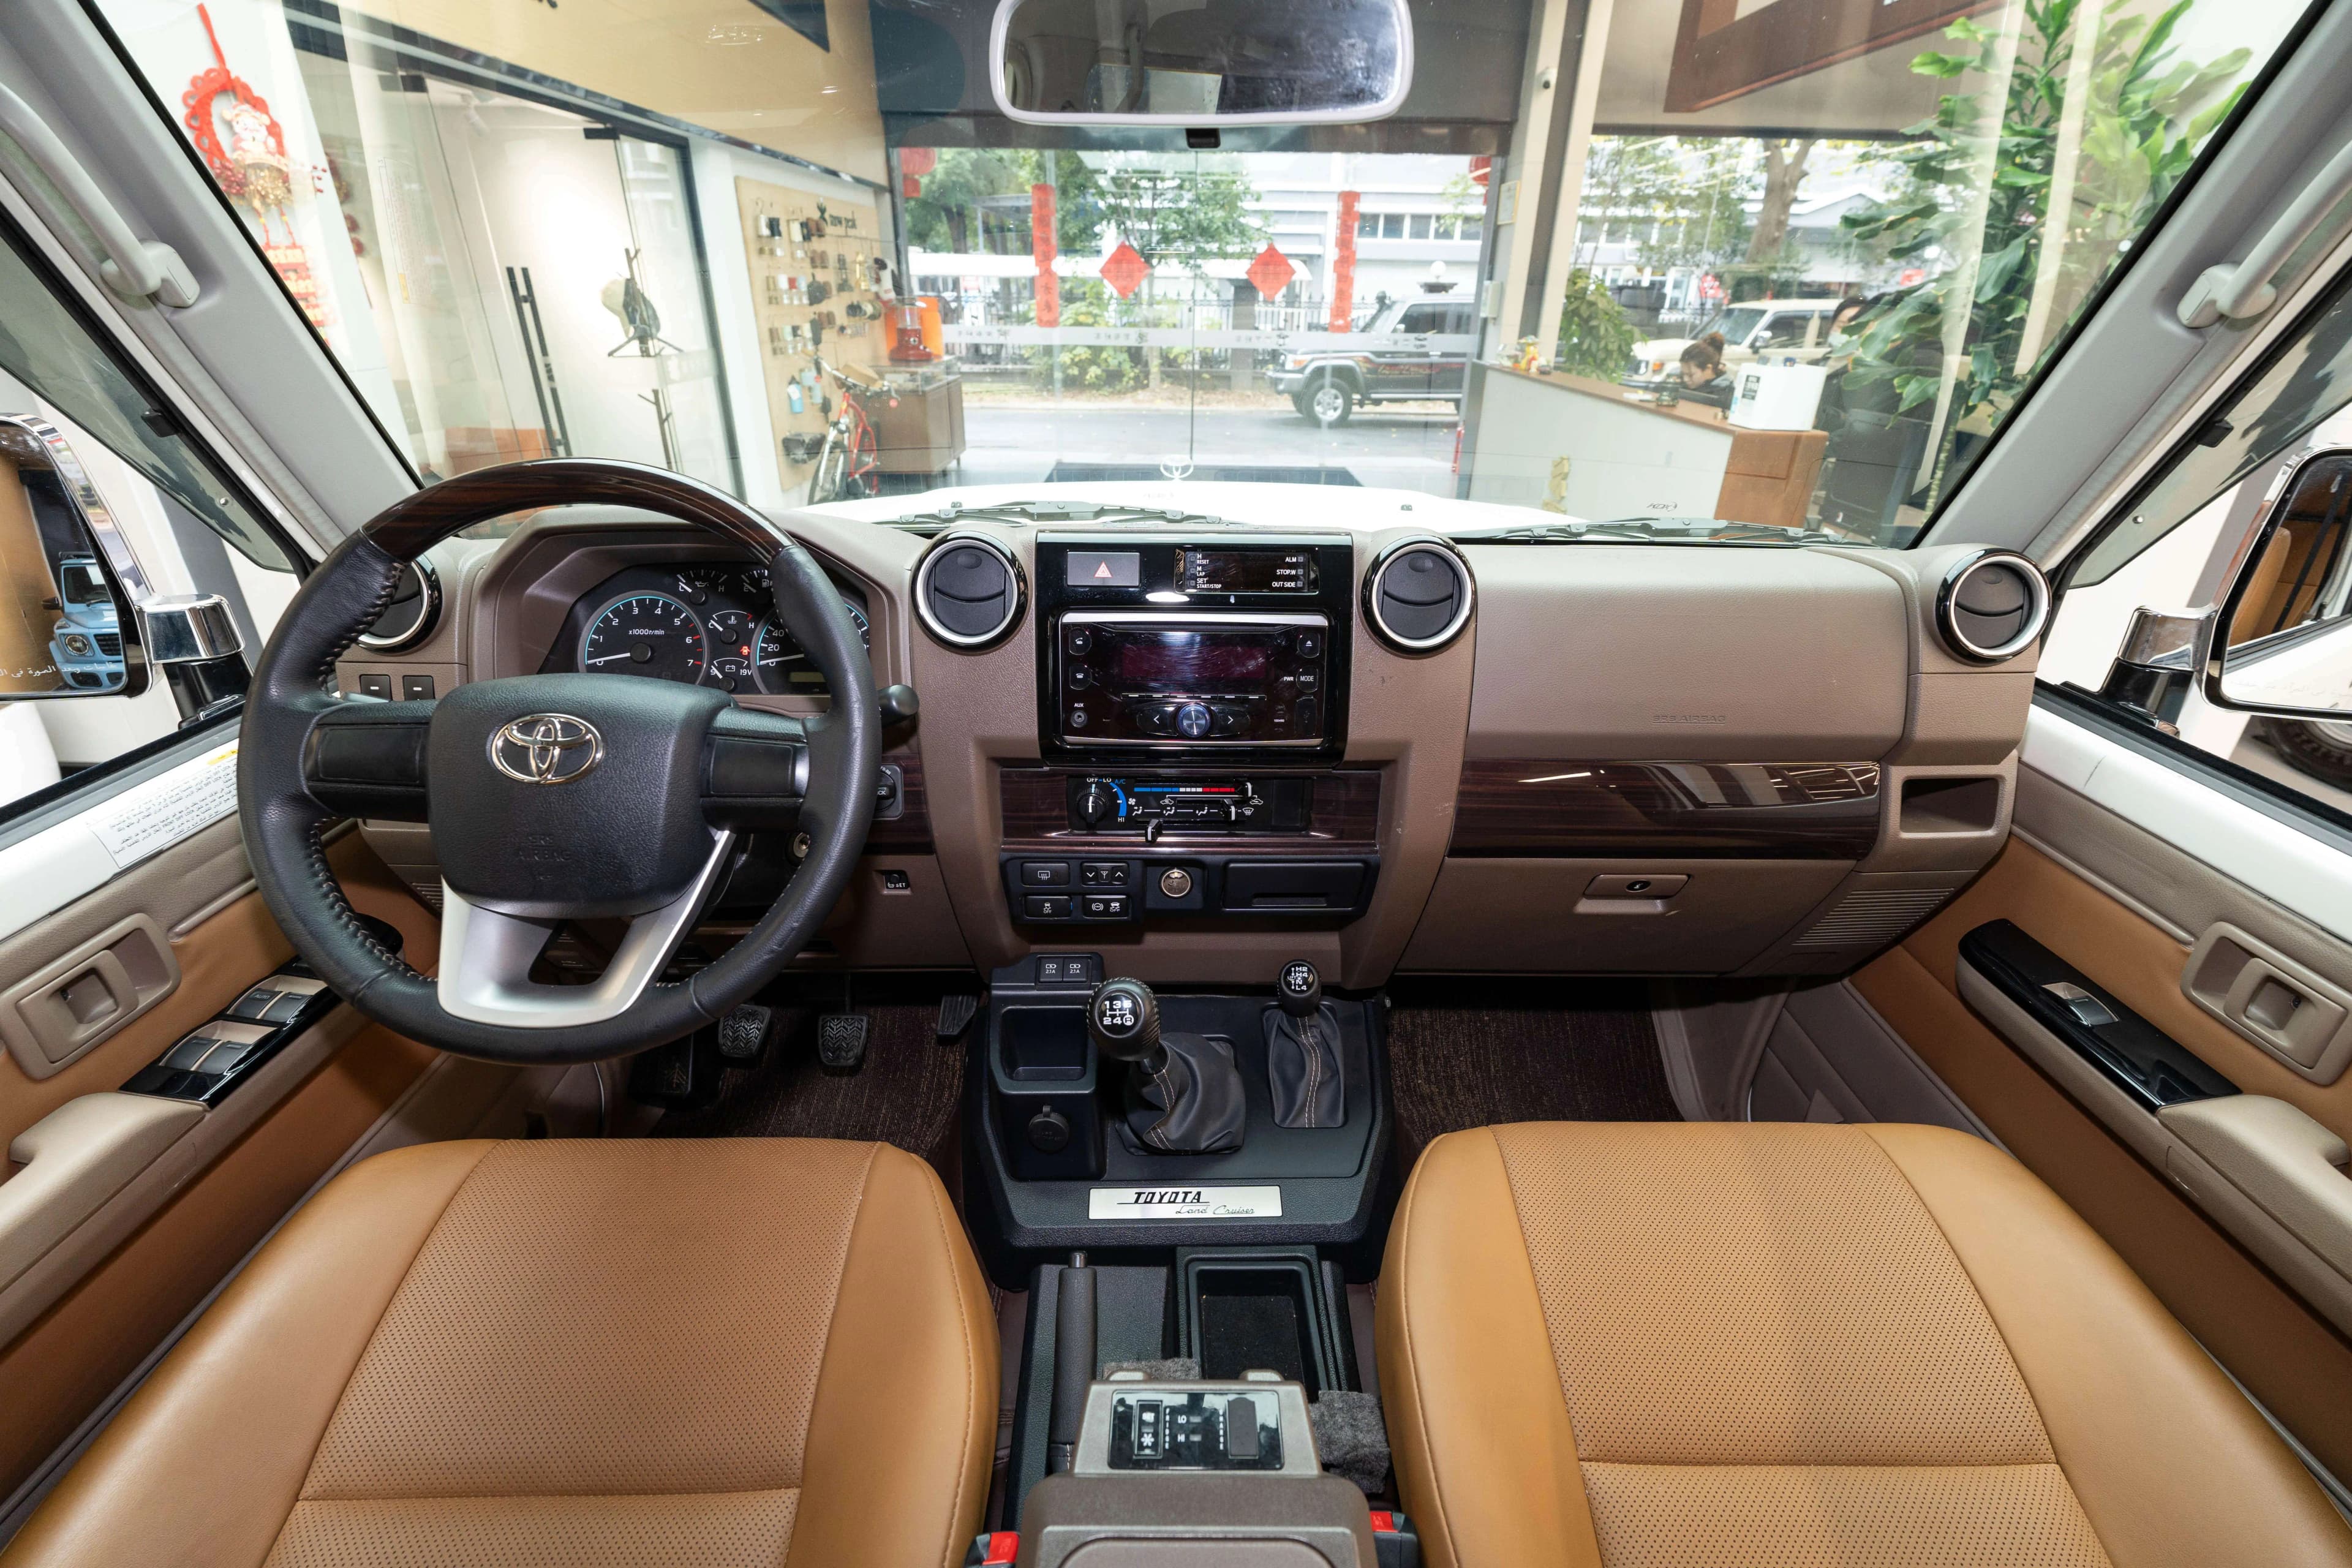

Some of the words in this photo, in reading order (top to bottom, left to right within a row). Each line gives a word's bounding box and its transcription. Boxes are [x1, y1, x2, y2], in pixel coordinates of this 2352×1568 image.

[27, 665, 56, 677] الصورة
[1134, 1191, 1202, 1204] TOYOTA
[1176, 1205, 1210, 1214] Land
[1213, 1205, 1254, 1215] Cruiser
[1177, 1415, 1187, 1424] LO
[1177, 1433, 1185, 1442] HI
